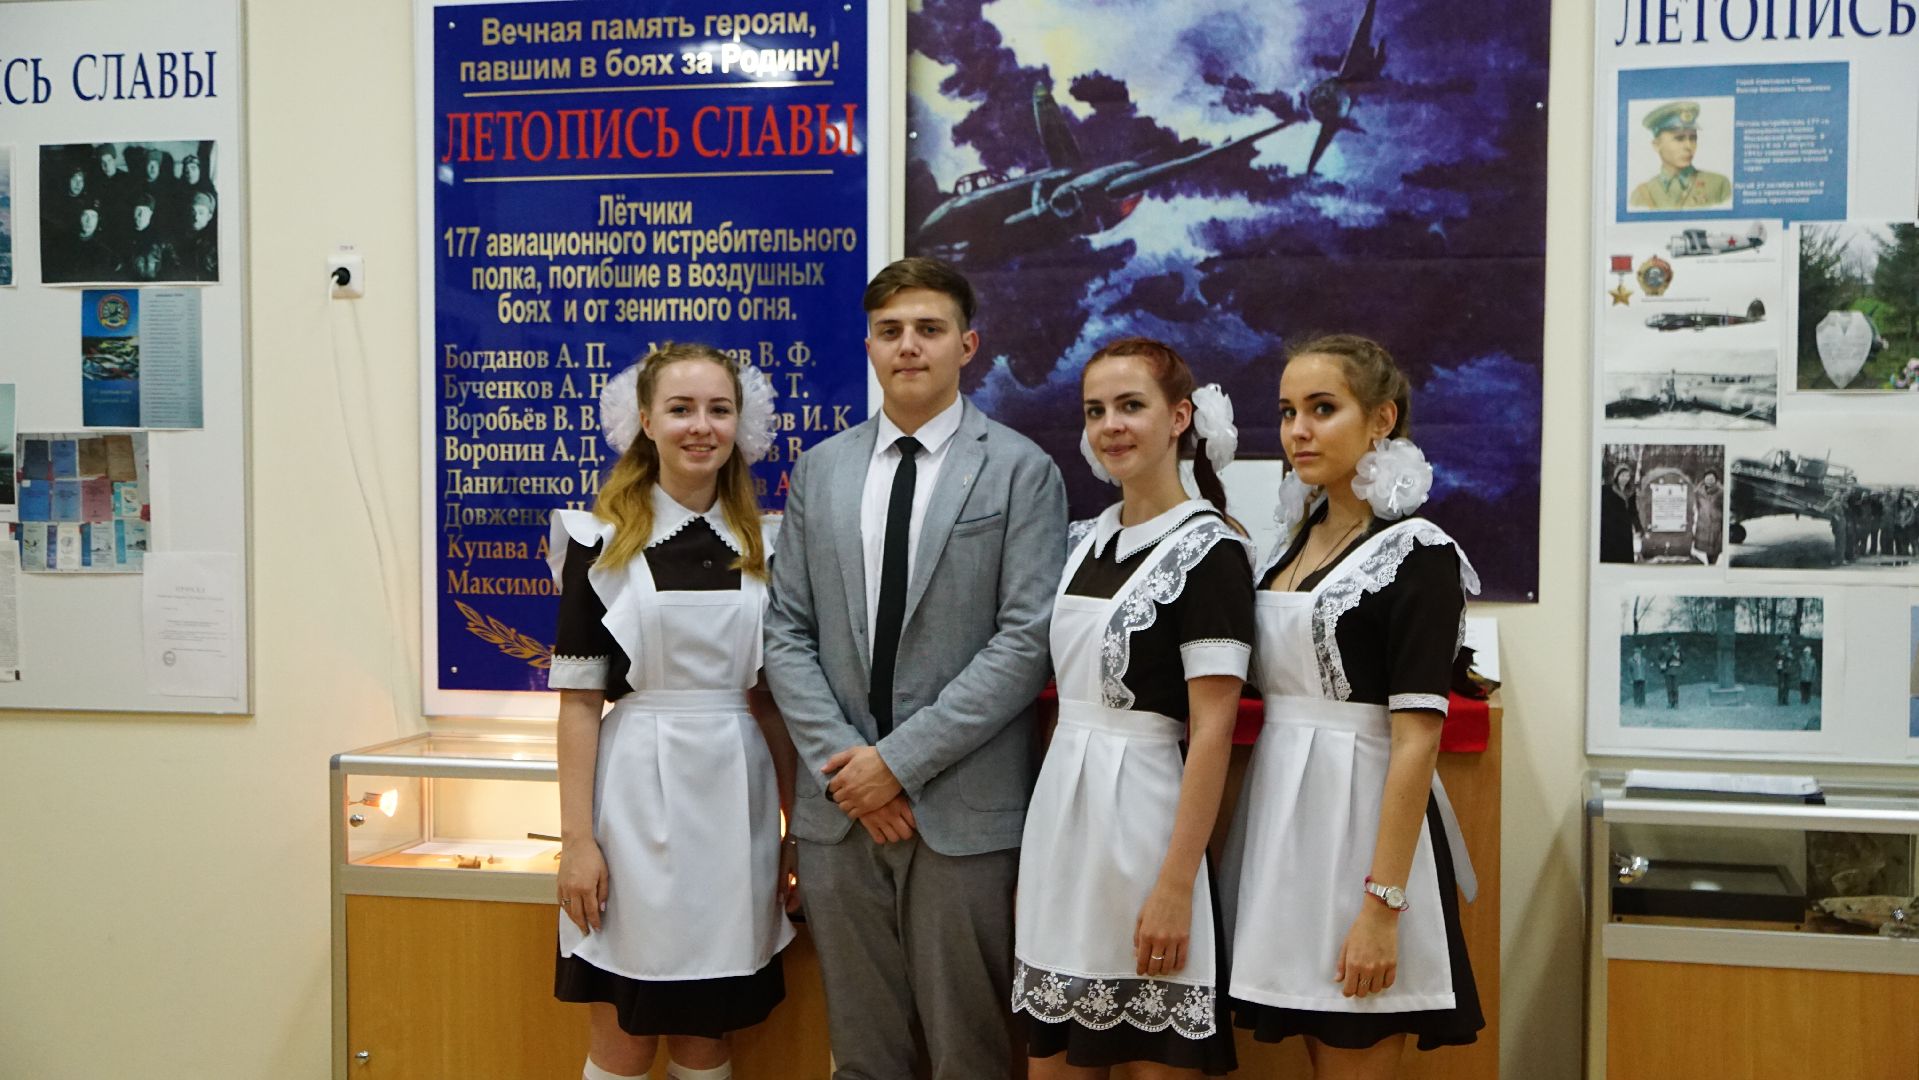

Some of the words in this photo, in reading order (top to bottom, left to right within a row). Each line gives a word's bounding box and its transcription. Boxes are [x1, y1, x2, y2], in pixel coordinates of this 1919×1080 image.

[482, 17, 583, 46] Вечная
[591, 15, 695, 41] память
[704, 11, 816, 43] героям,
[1615, 0, 1917, 47] ЛЕТОПИСЬ
[0, 57, 52, 105] СЬ
[73, 51, 217, 101] СЛАВЫ
[459, 56, 571, 83] павшим
[580, 55, 597, 78] в
[605, 48, 673, 77] боях
[681, 50, 713, 75] за
[721, 41, 841, 80] Родину!
[441, 108, 680, 162] ЛЕТОПИСЬ
[692, 103, 858, 158] СЛАВЫ
[598, 194, 693, 226] Лётчики
[444, 226, 480, 257] 177
[486, 233, 646, 262] авиационного
[653, 222, 857, 258] истребительного
[471, 262, 541, 294] полка,
[549, 257, 661, 291] погибшие
[667, 261, 682, 287] в
[688, 259, 825, 296] воздушных
[497, 295, 551, 325] боях
[564, 300, 577, 323] и
[583, 300, 607, 322] от
[614, 297, 731, 323] зенитного
[738, 297, 797, 324] огня.
[444, 344, 549, 372] Богданов
[555, 343, 579, 368] А.
[586, 342, 611, 368] П.
[758, 341, 781, 367] В.
[787, 341, 816, 366] Ф.
[444, 374, 553, 407] Бученков
[559, 373, 583, 398] А.
[785, 372, 809, 398] Т.
[444, 405, 547, 438] Воробьёв
[553, 405, 574, 430] В.
[580, 405, 600, 430] В.
[802, 405, 828, 431] И.
[444, 436, 545, 469] Воронин
[551, 436, 575, 461] А.
[579, 436, 605, 467] Д.
[444, 469, 573, 499] Даниленко
[444, 503, 551, 533] Довженк
[447, 535, 528, 566] Купава
